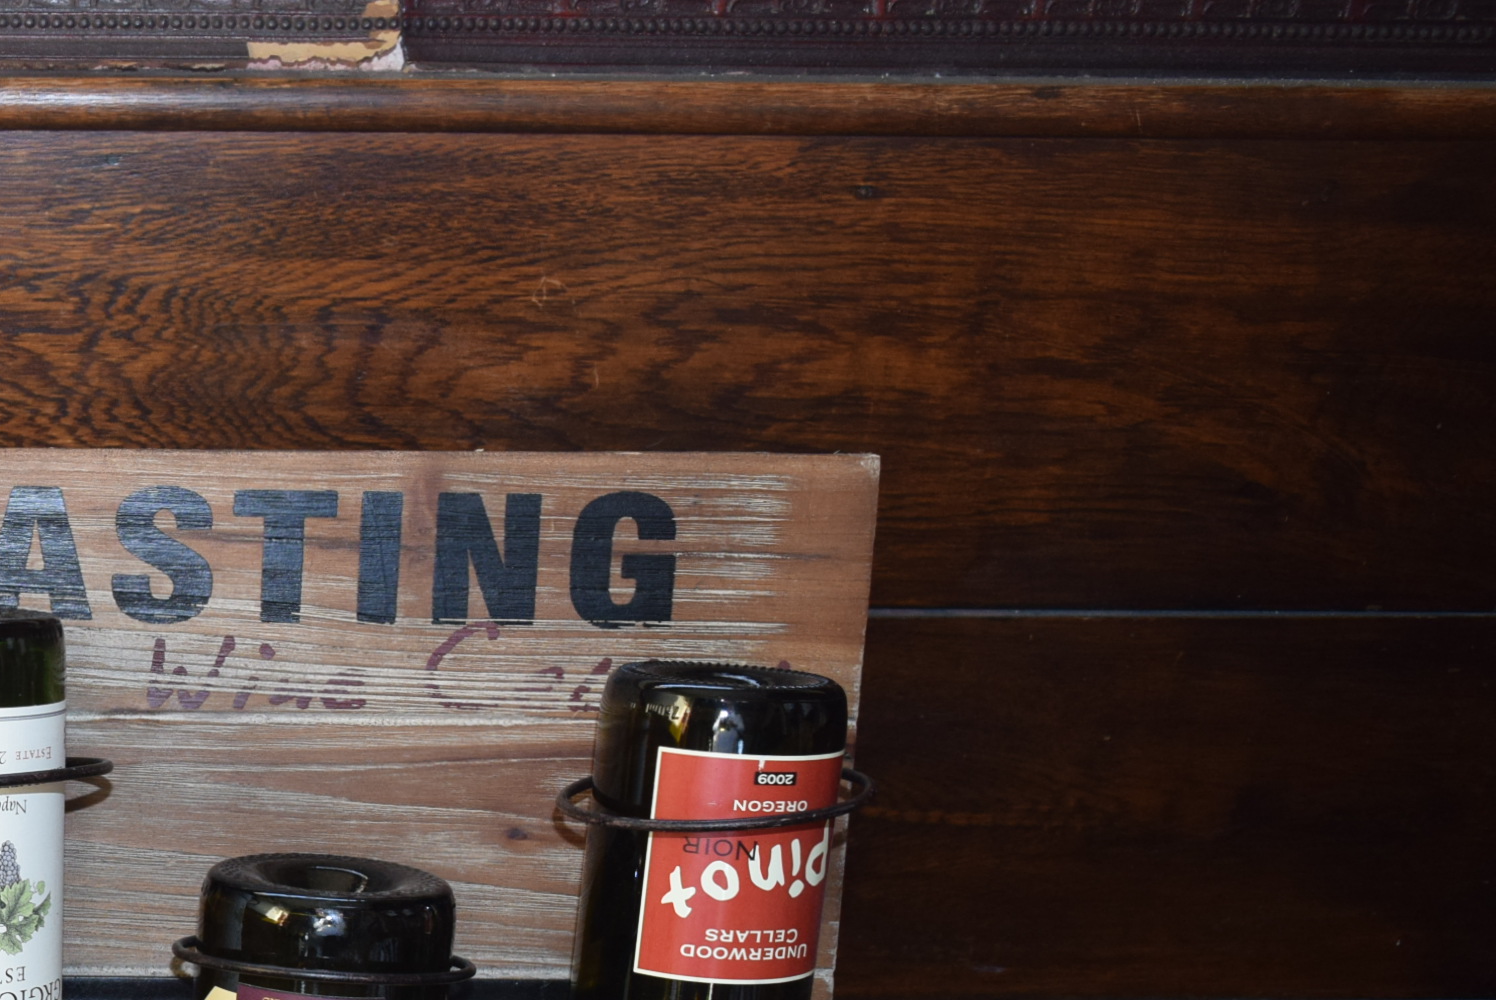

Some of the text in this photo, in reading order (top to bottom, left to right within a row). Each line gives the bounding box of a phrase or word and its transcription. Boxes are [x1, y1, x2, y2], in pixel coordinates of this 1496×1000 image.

[15, 746, 52, 761] ESTATE
[757, 773, 795, 785] 2009
[733, 799, 808, 813] OREGON
[682, 836, 759, 861] NOIR
[661, 819, 830, 919] pinot
[704, 928, 798, 943] CELLARS
[680, 943, 808, 960] UNDERWOOD
